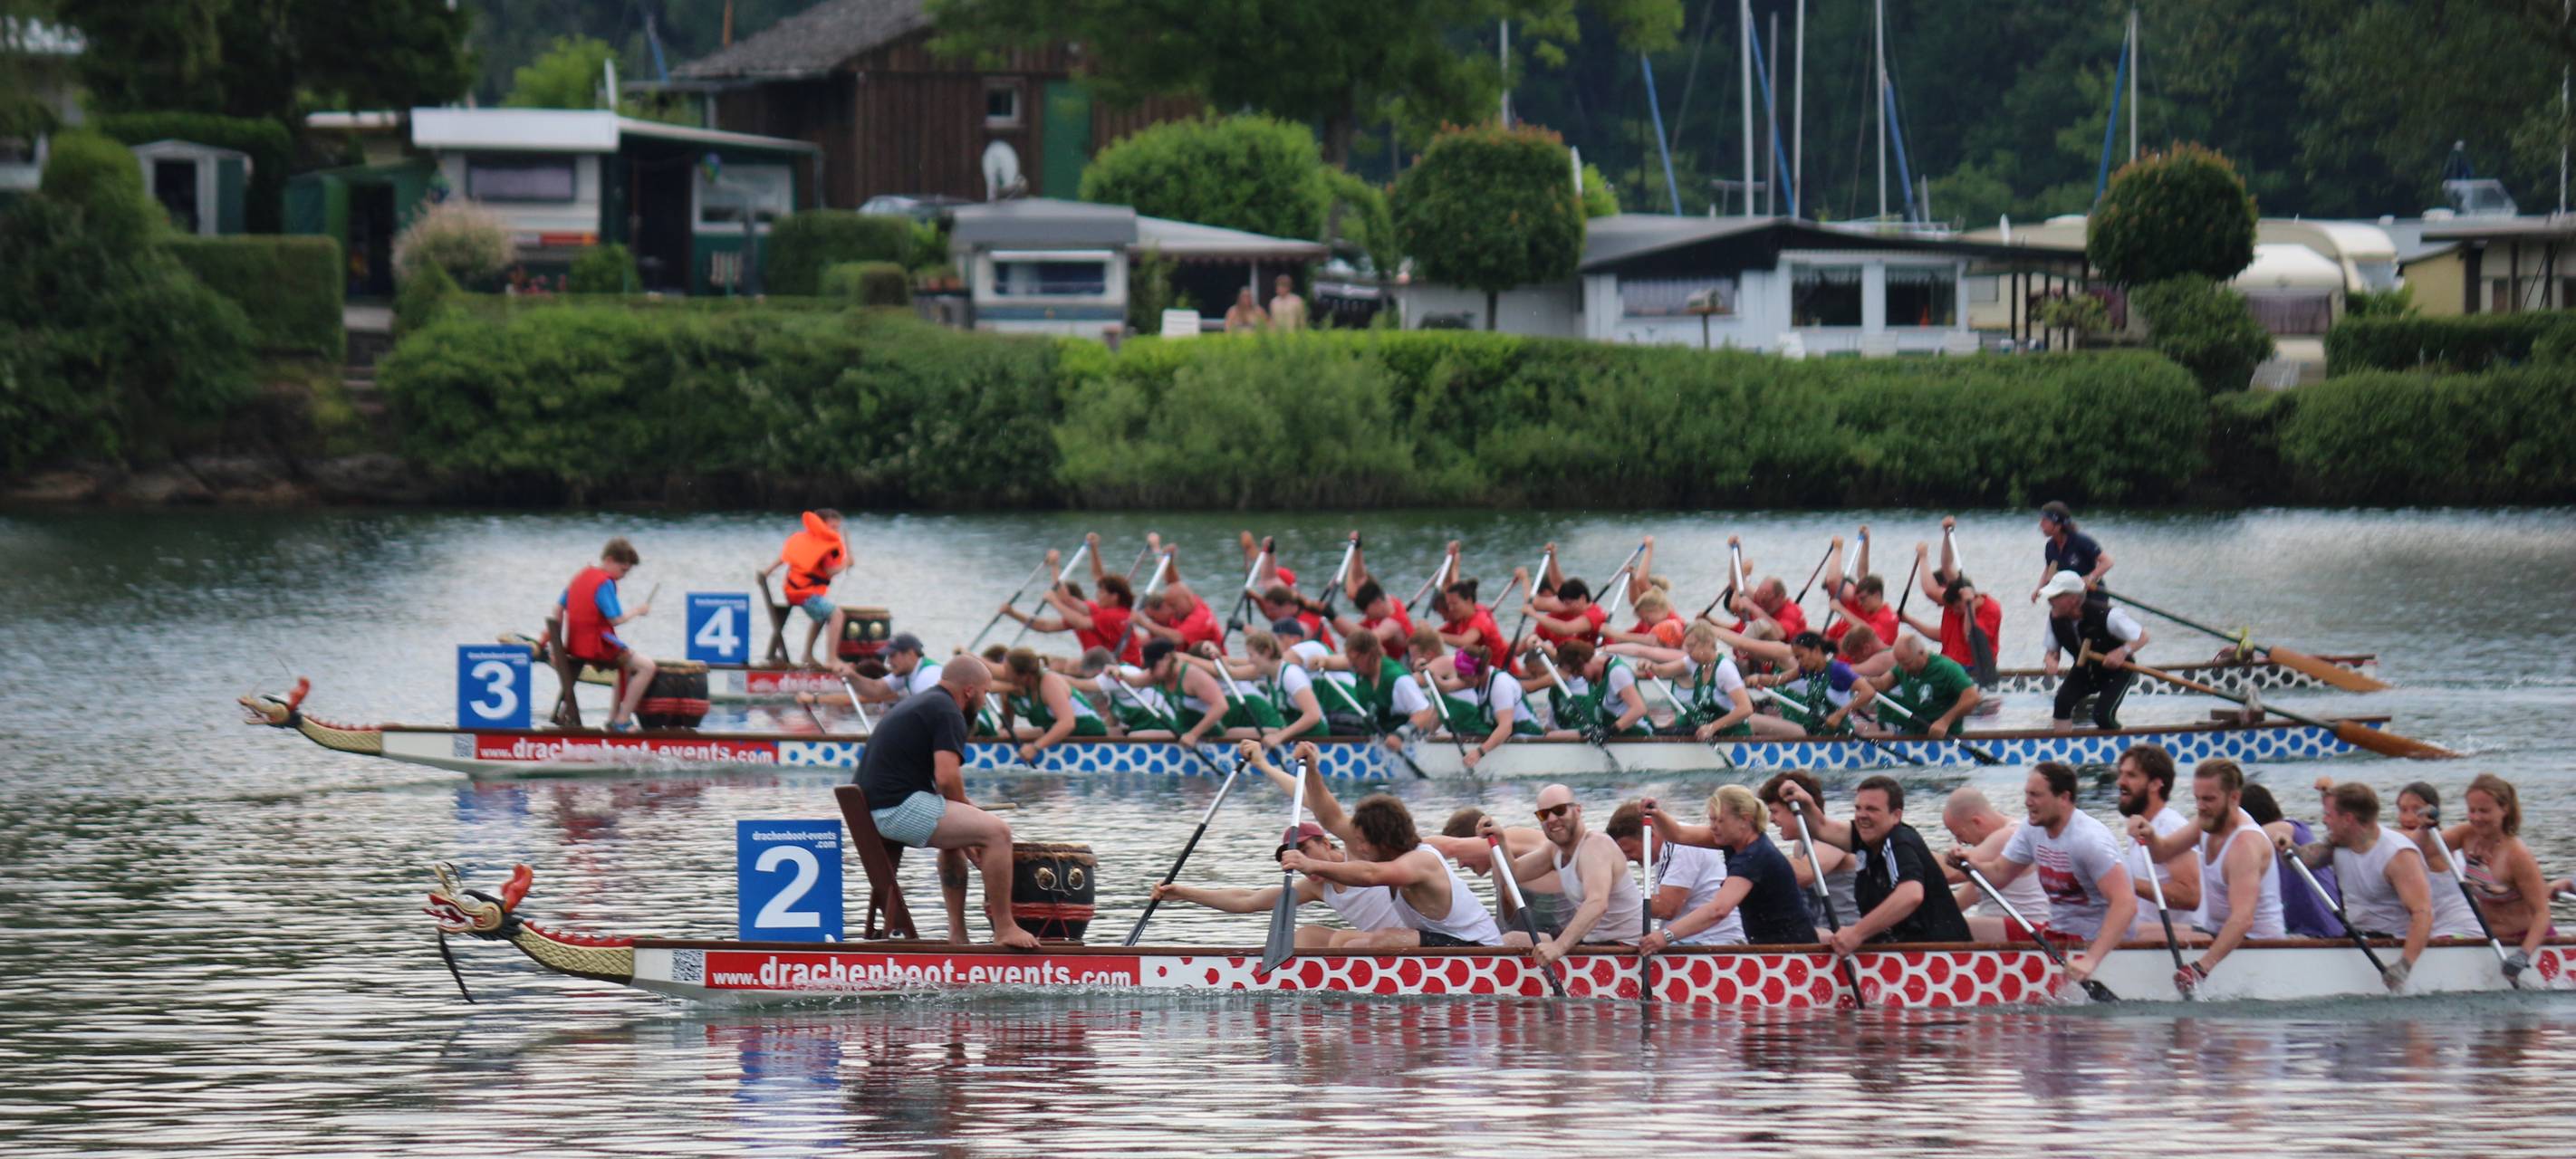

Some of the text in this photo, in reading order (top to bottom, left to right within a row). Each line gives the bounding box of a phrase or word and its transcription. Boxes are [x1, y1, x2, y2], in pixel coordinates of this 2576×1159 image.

[695, 606, 740, 657] 4
[469, 659, 518, 720] 3
[752, 830, 837, 841] drachenboot-events
[754, 845, 821, 928] 2
[712, 955, 1131, 987] www.drachenboot-events.com
